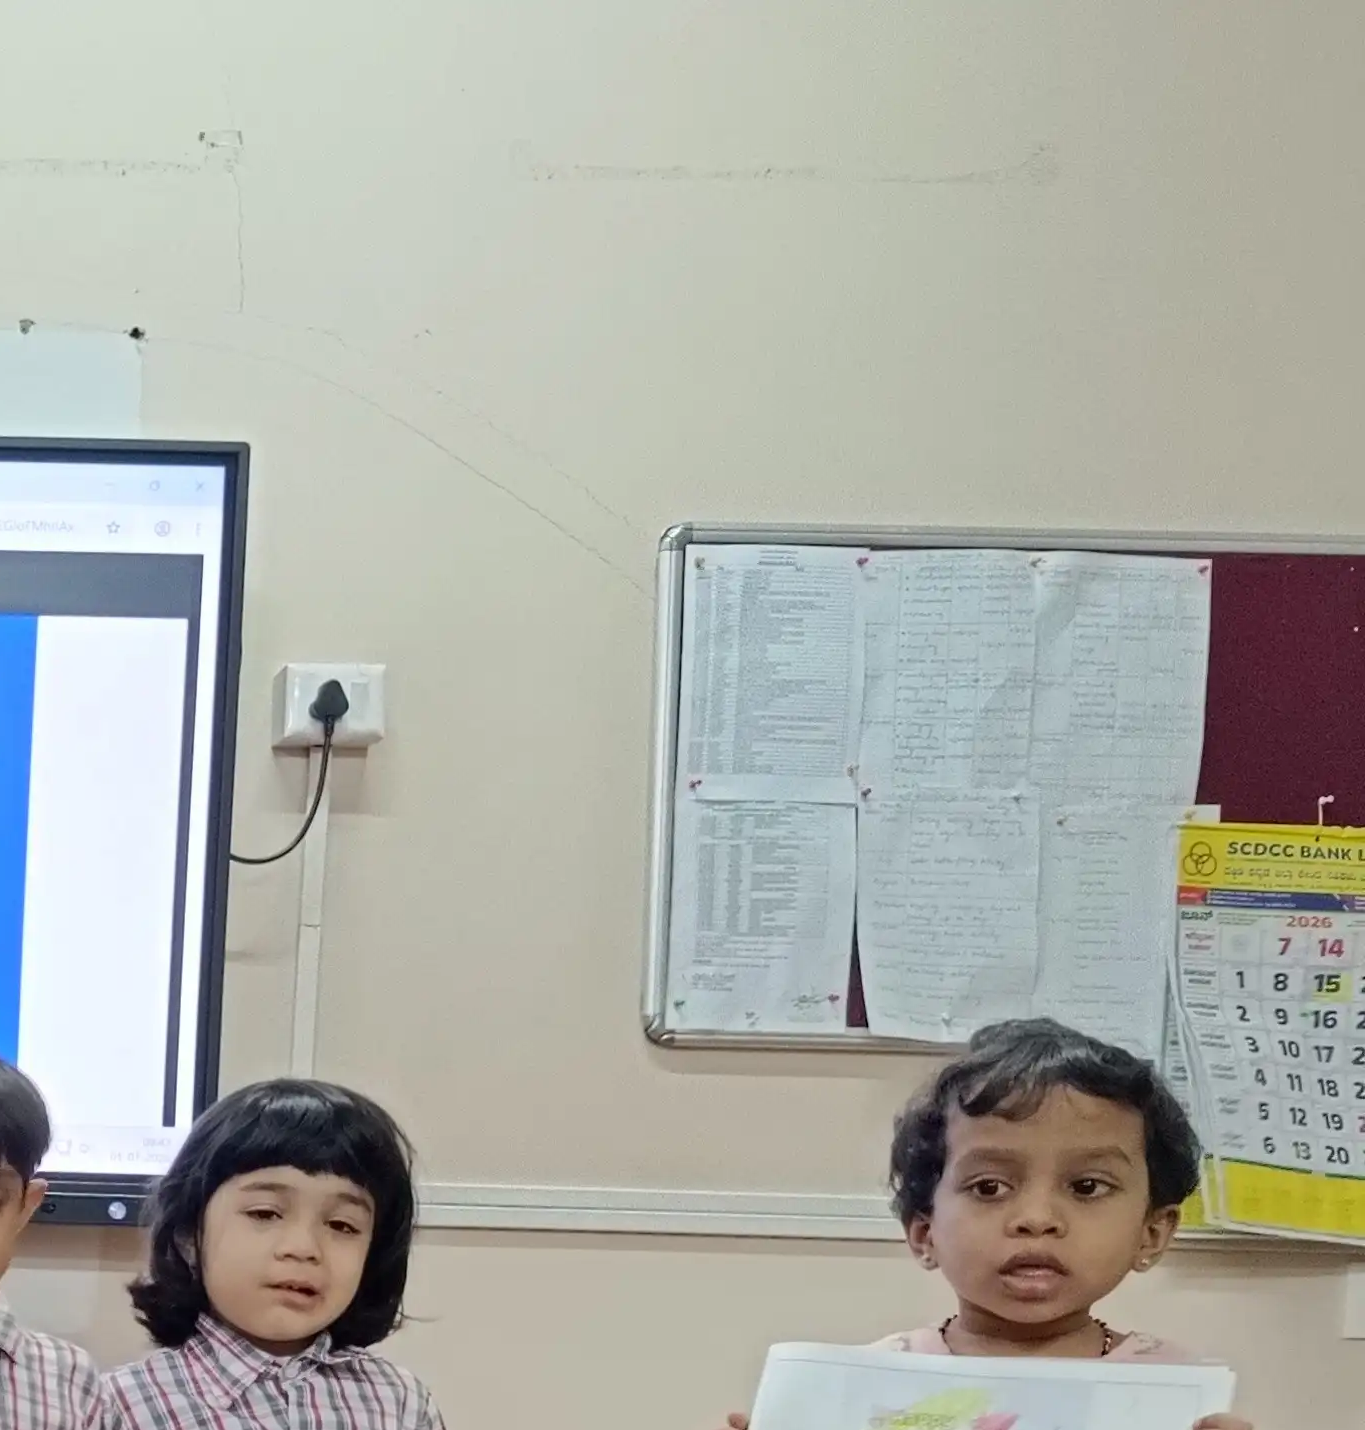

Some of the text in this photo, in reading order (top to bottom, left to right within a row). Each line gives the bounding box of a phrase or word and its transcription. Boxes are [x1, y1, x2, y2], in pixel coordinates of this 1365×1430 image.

[1227, 842, 1294, 857] SCDCC
[1300, 845, 1352, 861] BANK
[1286, 916, 1333, 928] 2026
[1278, 937, 1345, 958] 7 14
[1236, 971, 1245, 989] 1
[1273, 973, 1289, 991] 8
[1314, 974, 1341, 992] 15
[1236, 1005, 1251, 1022] 2
[1274, 1008, 1288, 1025] 9
[1312, 1010, 1338, 1029] 16
[1245, 1036, 1260, 1053] 3
[1278, 1040, 1301, 1059] 10
[1313, 1045, 1335, 1063] 17
[1254, 1069, 1268, 1087] 4
[1287, 1073, 1303, 1093] 11
[1317, 1078, 1339, 1098] 18
[1259, 1102, 1269, 1121] 5
[1289, 1107, 1308, 1127] 12
[1322, 1112, 1344, 1131] 19
[1263, 1137, 1276, 1154] 6
[1292, 1141, 1312, 1160] 13
[1325, 1145, 1350, 1165] 20
